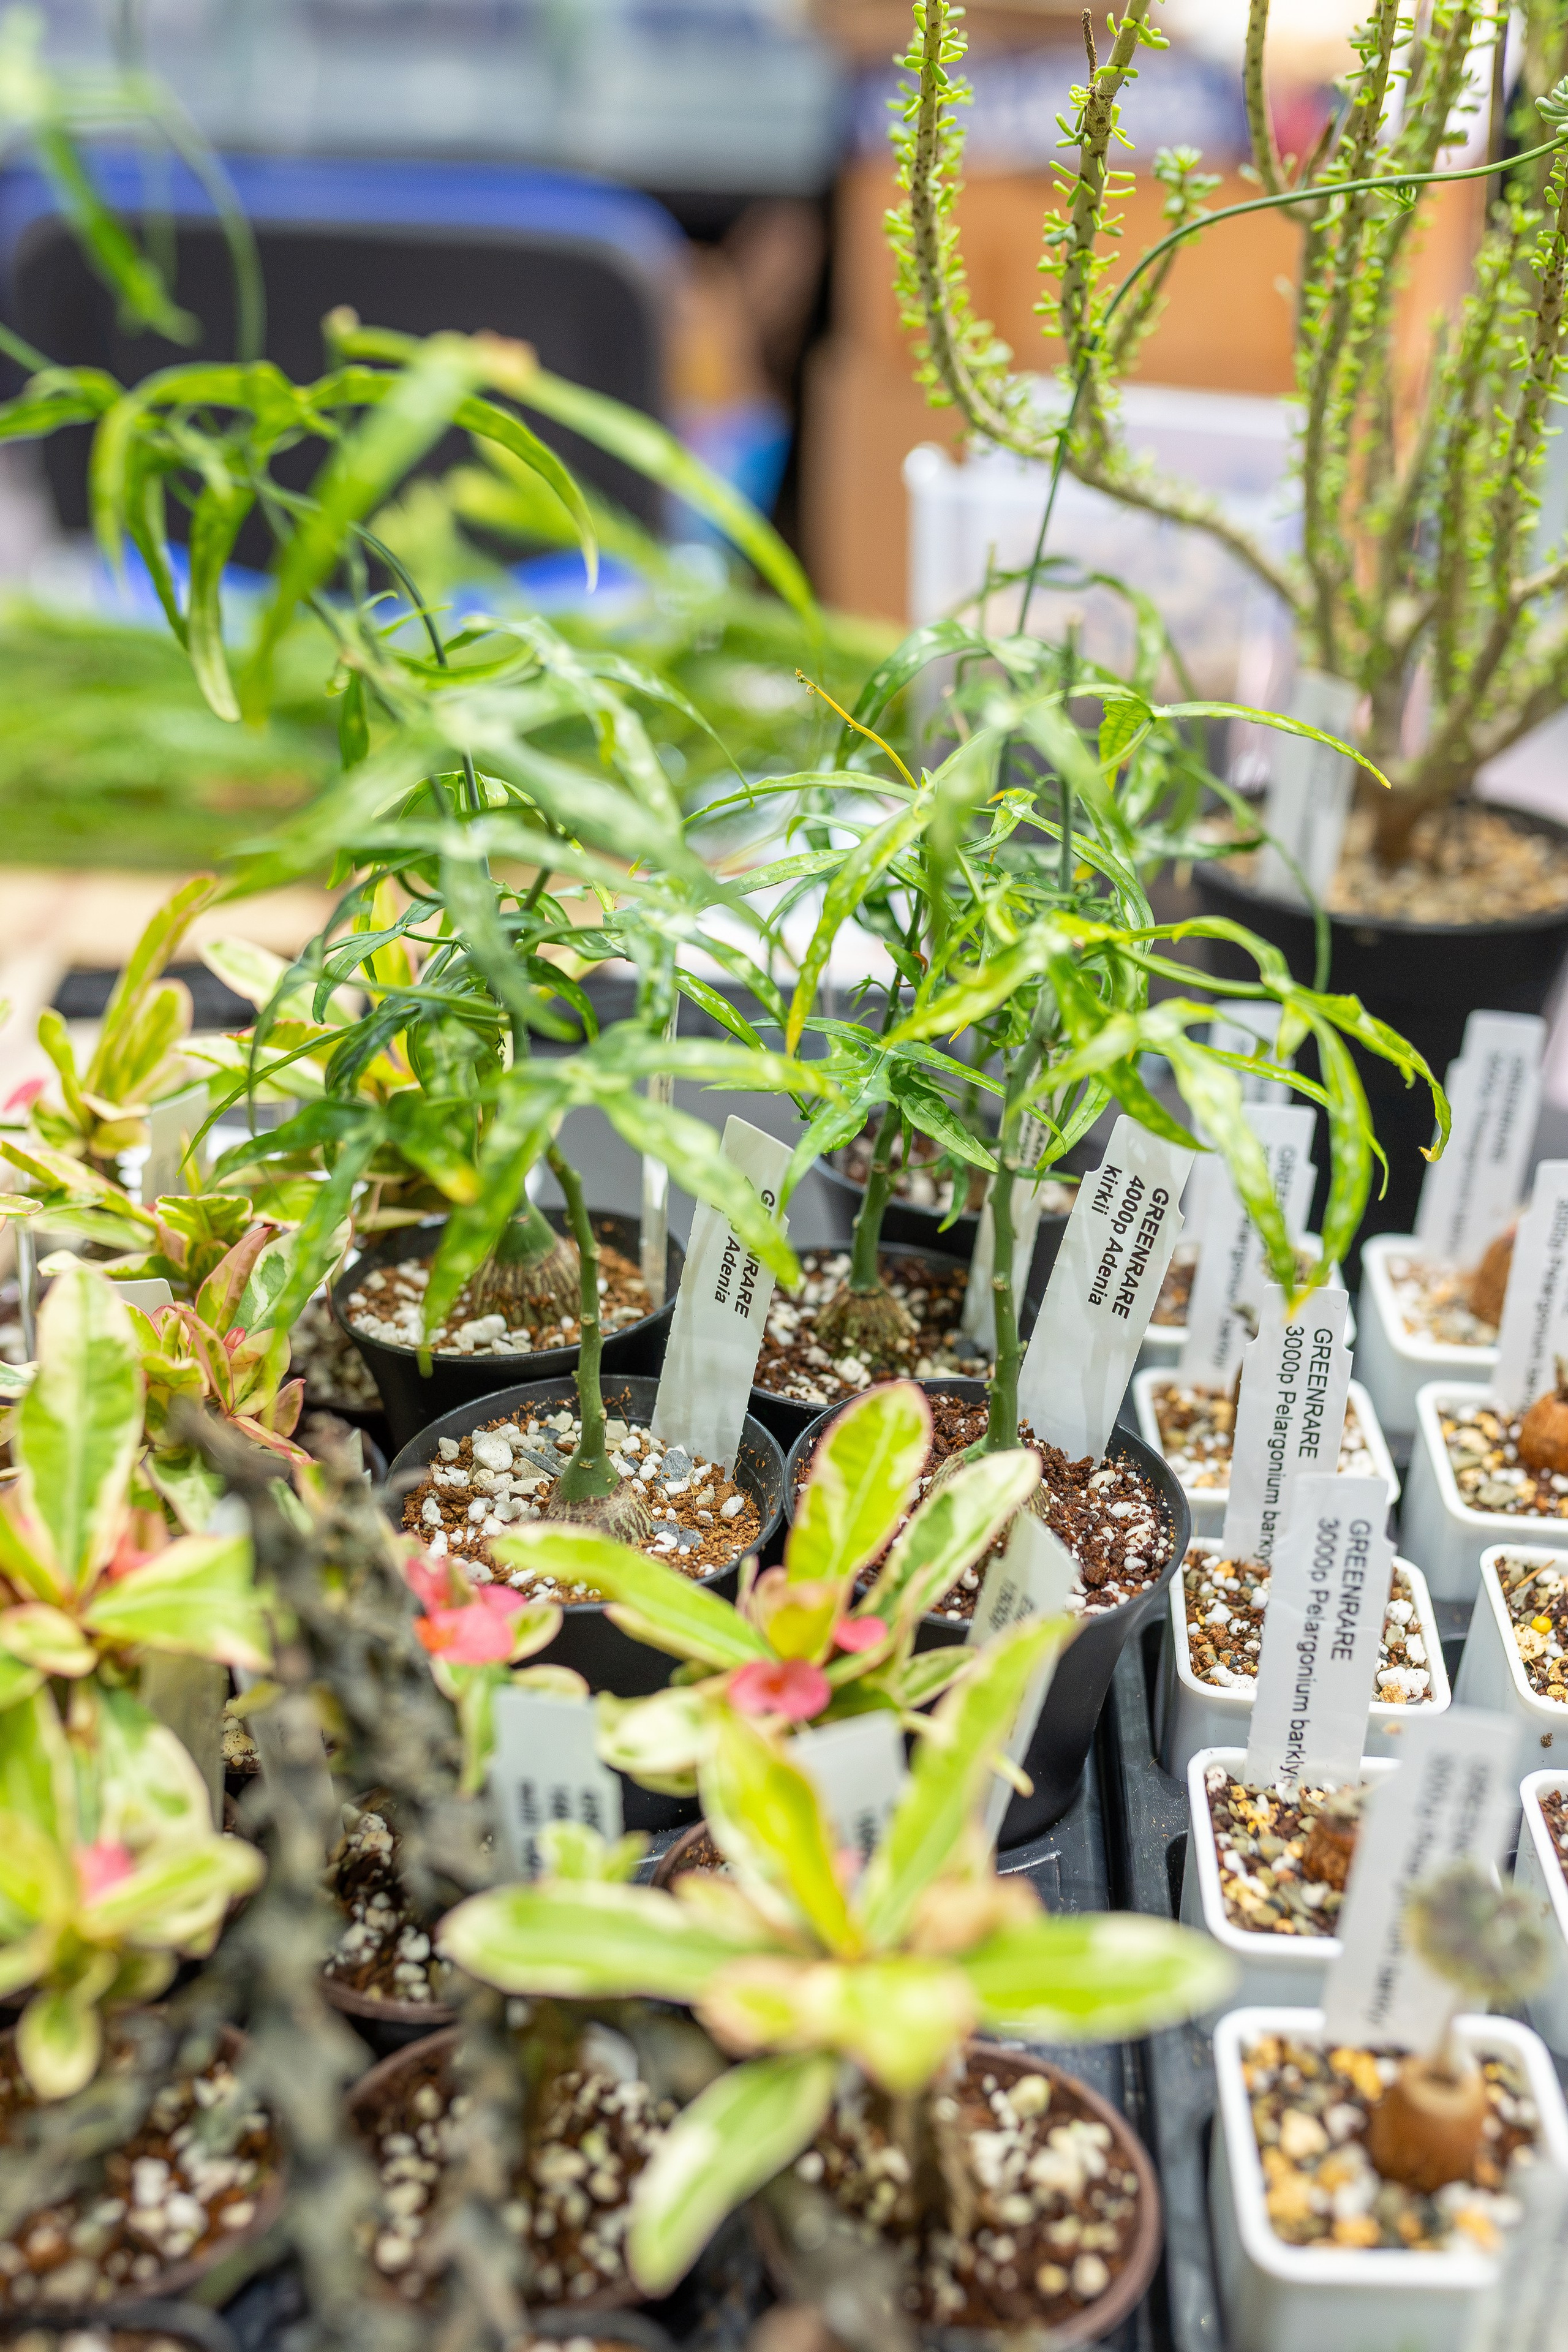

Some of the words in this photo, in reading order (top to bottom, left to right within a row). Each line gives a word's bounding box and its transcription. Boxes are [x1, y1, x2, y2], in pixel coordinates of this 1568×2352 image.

[1110, 1175, 1145, 1235] 4000p
[1111, 1188, 1169, 1319] GREENRARE
[1088, 1236, 1124, 1306] Adenia
[1276, 1325, 1305, 1384] 3000p
[1298, 1328, 1333, 1459] GREENRARE
[1264, 1390, 1297, 1504] Pelargonium
[1308, 1517, 1341, 1582] 3000p
[1330, 1518, 1371, 1661] GREENRARE
[1292, 1589, 1330, 1713] Pelargonium
